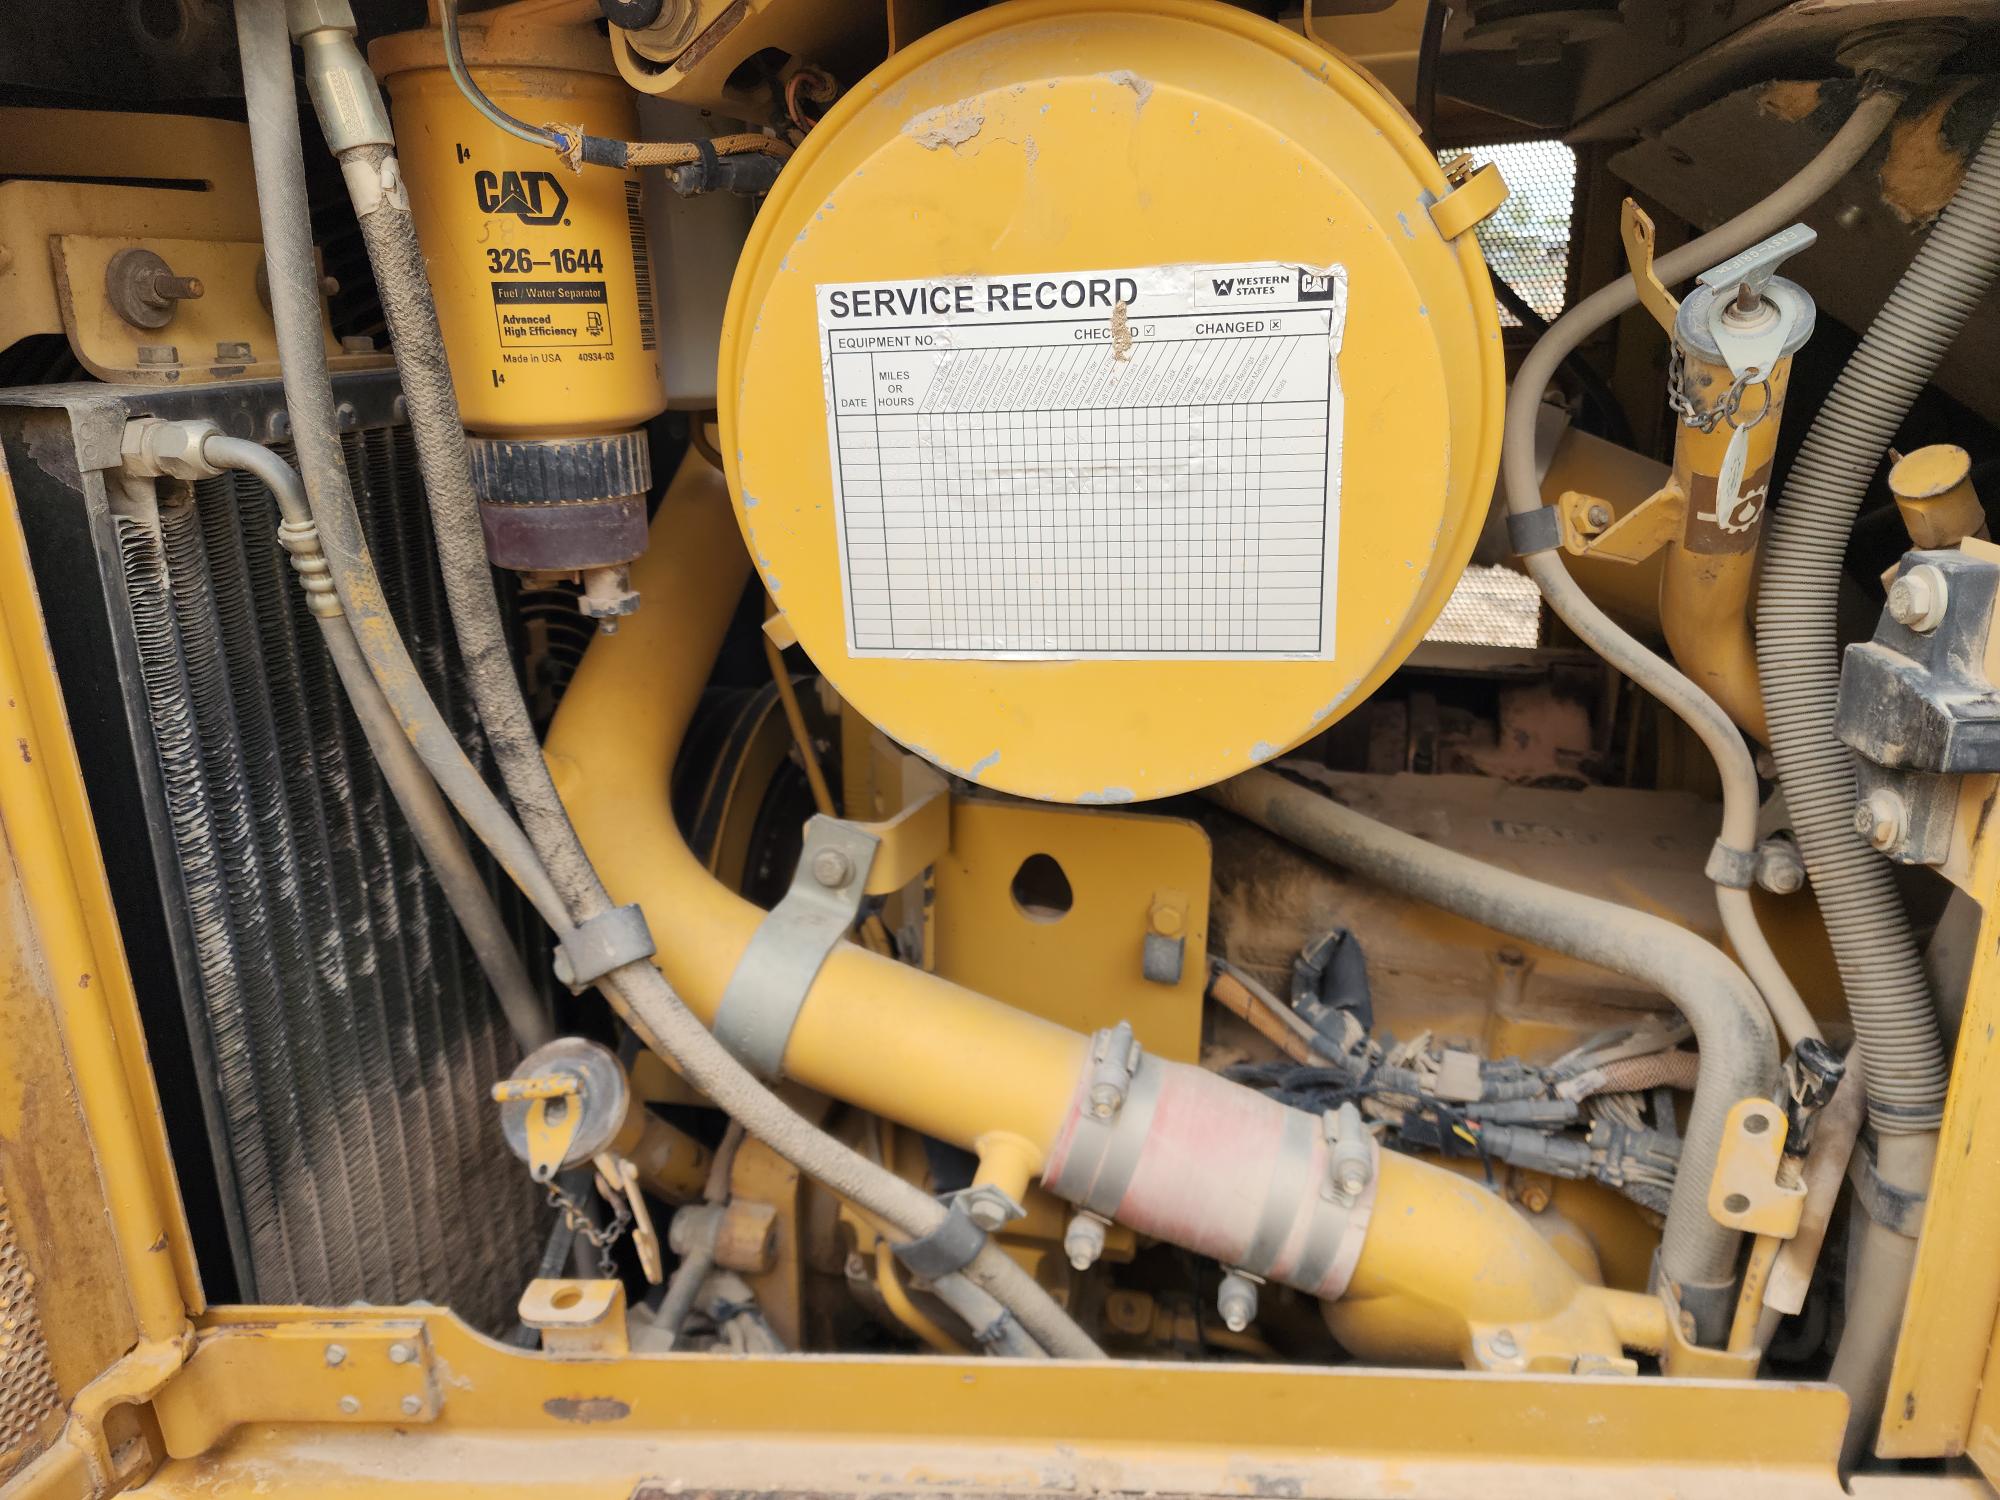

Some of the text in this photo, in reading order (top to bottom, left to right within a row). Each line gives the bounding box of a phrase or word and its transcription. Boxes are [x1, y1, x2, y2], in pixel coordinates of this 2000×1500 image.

[475, 171, 550, 215] CAT
[486, 248, 603, 273] 326-1644
[1236, 275, 1290, 285] WESTERN
[499, 288, 518, 298] Fuel
[526, 288, 555, 298] Water
[558, 288, 601, 300] Separator
[1236, 287, 1275, 296] STATES
[830, 278, 1138, 318] SERVICE RECORD
[503, 314, 551, 324] Advanced
[504, 326, 527, 338] High
[529, 326, 577, 338] Efficiency
[838, 321, 1264, 349] EQUIPMENT NO. CHECD CHANGED
[503, 352, 615, 363] Made in USA 40934-03
[879, 371, 910, 381] MILES
[888, 385, 903, 393] OR
[841, 398, 867, 407] DATE
[878, 398, 914, 407] HOURS
